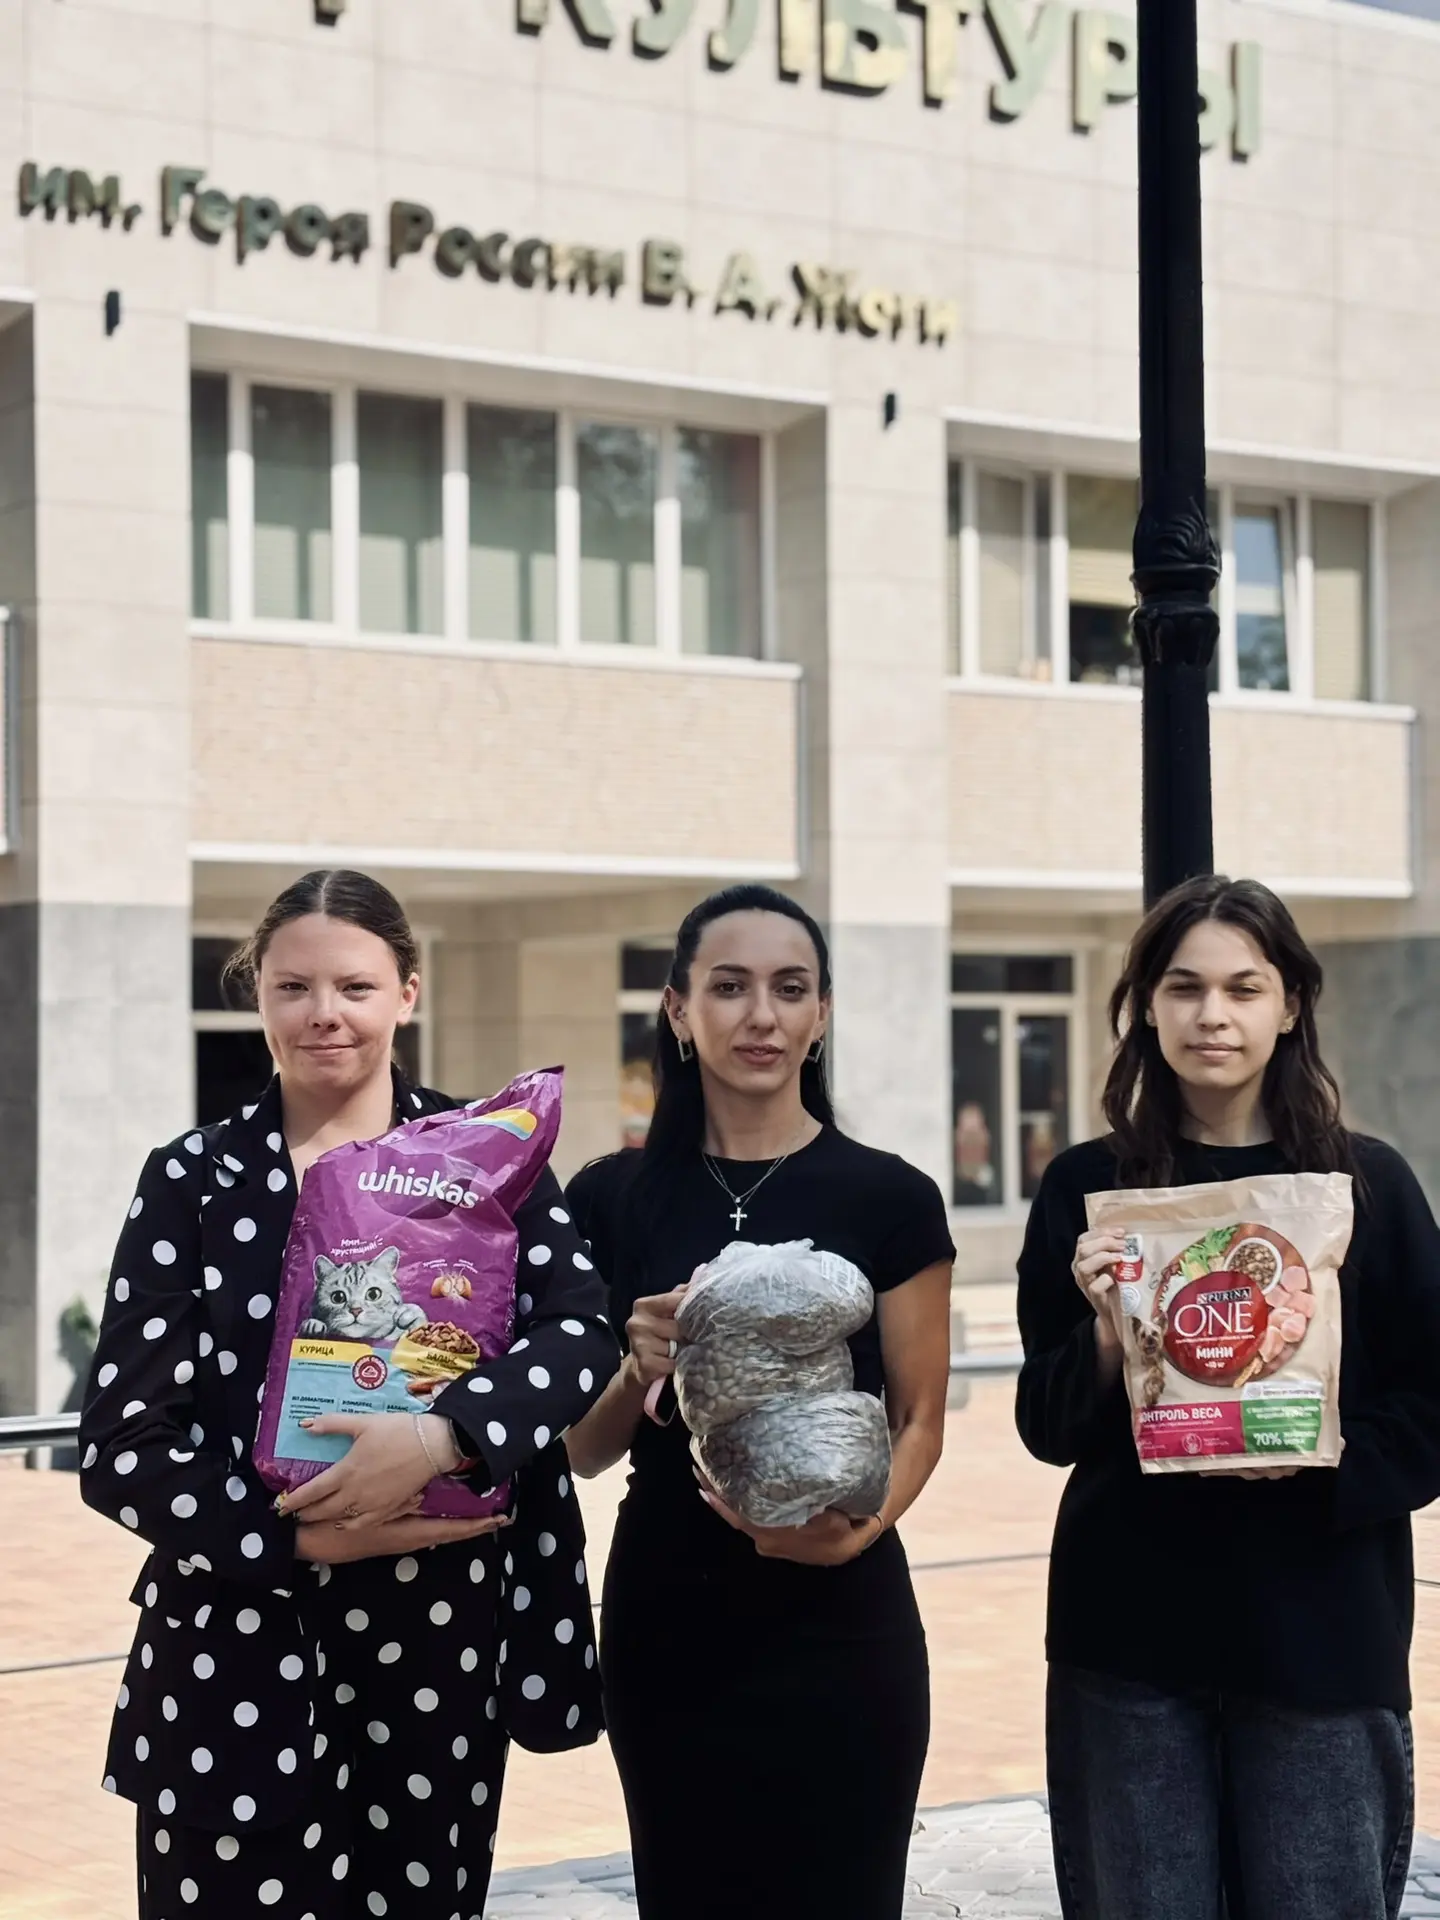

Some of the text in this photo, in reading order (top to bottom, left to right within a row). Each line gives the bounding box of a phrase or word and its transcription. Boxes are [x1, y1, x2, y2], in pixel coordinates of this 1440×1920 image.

[160, 165, 370, 267] Героя
[388, 200, 626, 299] России
[357, 1165, 479, 1209] whiskas
[1207, 1288, 1249, 1302] PURINA
[1174, 1301, 1255, 1337] ONE
[299, 1345, 334, 1356] КУРИЦА
[1196, 1346, 1233, 1359] МИНИ
[1192, 1407, 1222, 1419] ВЕСА
[1253, 1432, 1282, 1446] 70%
